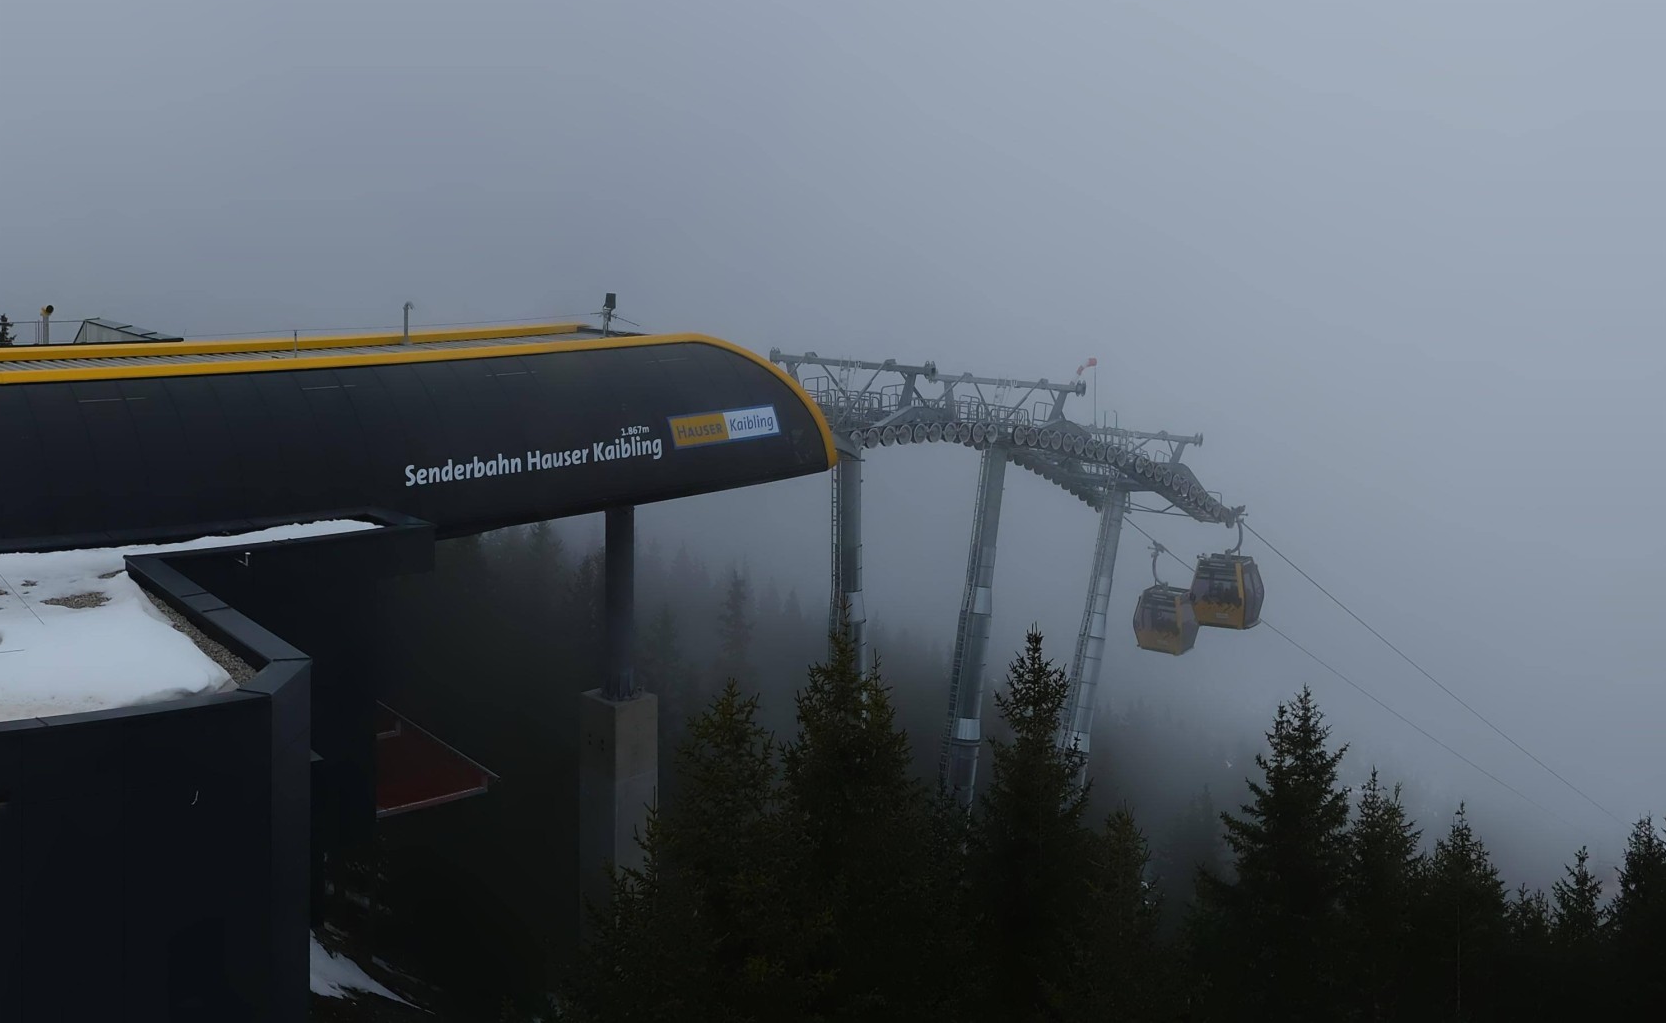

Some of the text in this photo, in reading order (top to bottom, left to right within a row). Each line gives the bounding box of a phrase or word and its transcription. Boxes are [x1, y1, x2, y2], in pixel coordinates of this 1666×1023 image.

[620, 425, 650, 437] 1.867m
[676, 413, 774, 440] HAUSER Kaibling
[405, 436, 663, 487] Senderbahn Hauser Kaibling
